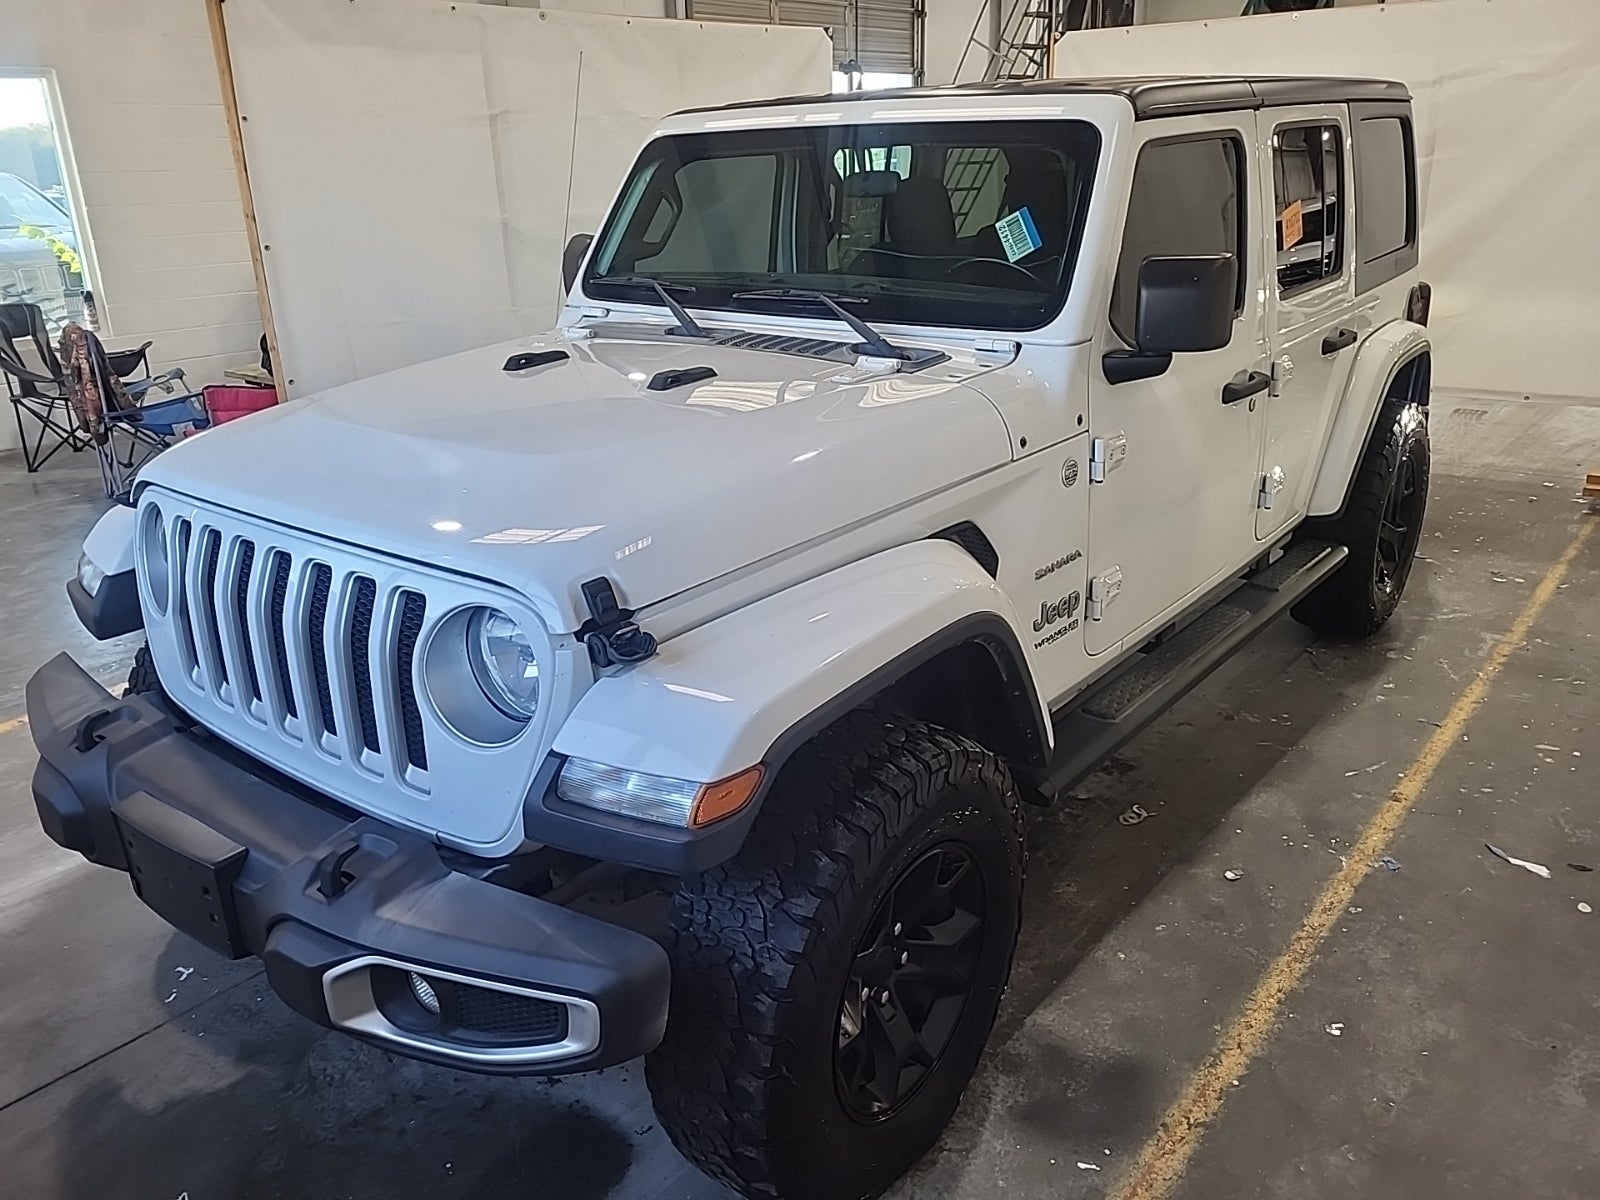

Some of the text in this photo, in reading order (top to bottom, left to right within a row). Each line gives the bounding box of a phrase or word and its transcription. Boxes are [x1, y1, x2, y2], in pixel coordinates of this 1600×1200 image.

[1034, 549, 1082, 581] SAHARA
[1032, 590, 1081, 633] Jeep
[1033, 618, 1079, 650] WRANGLER
